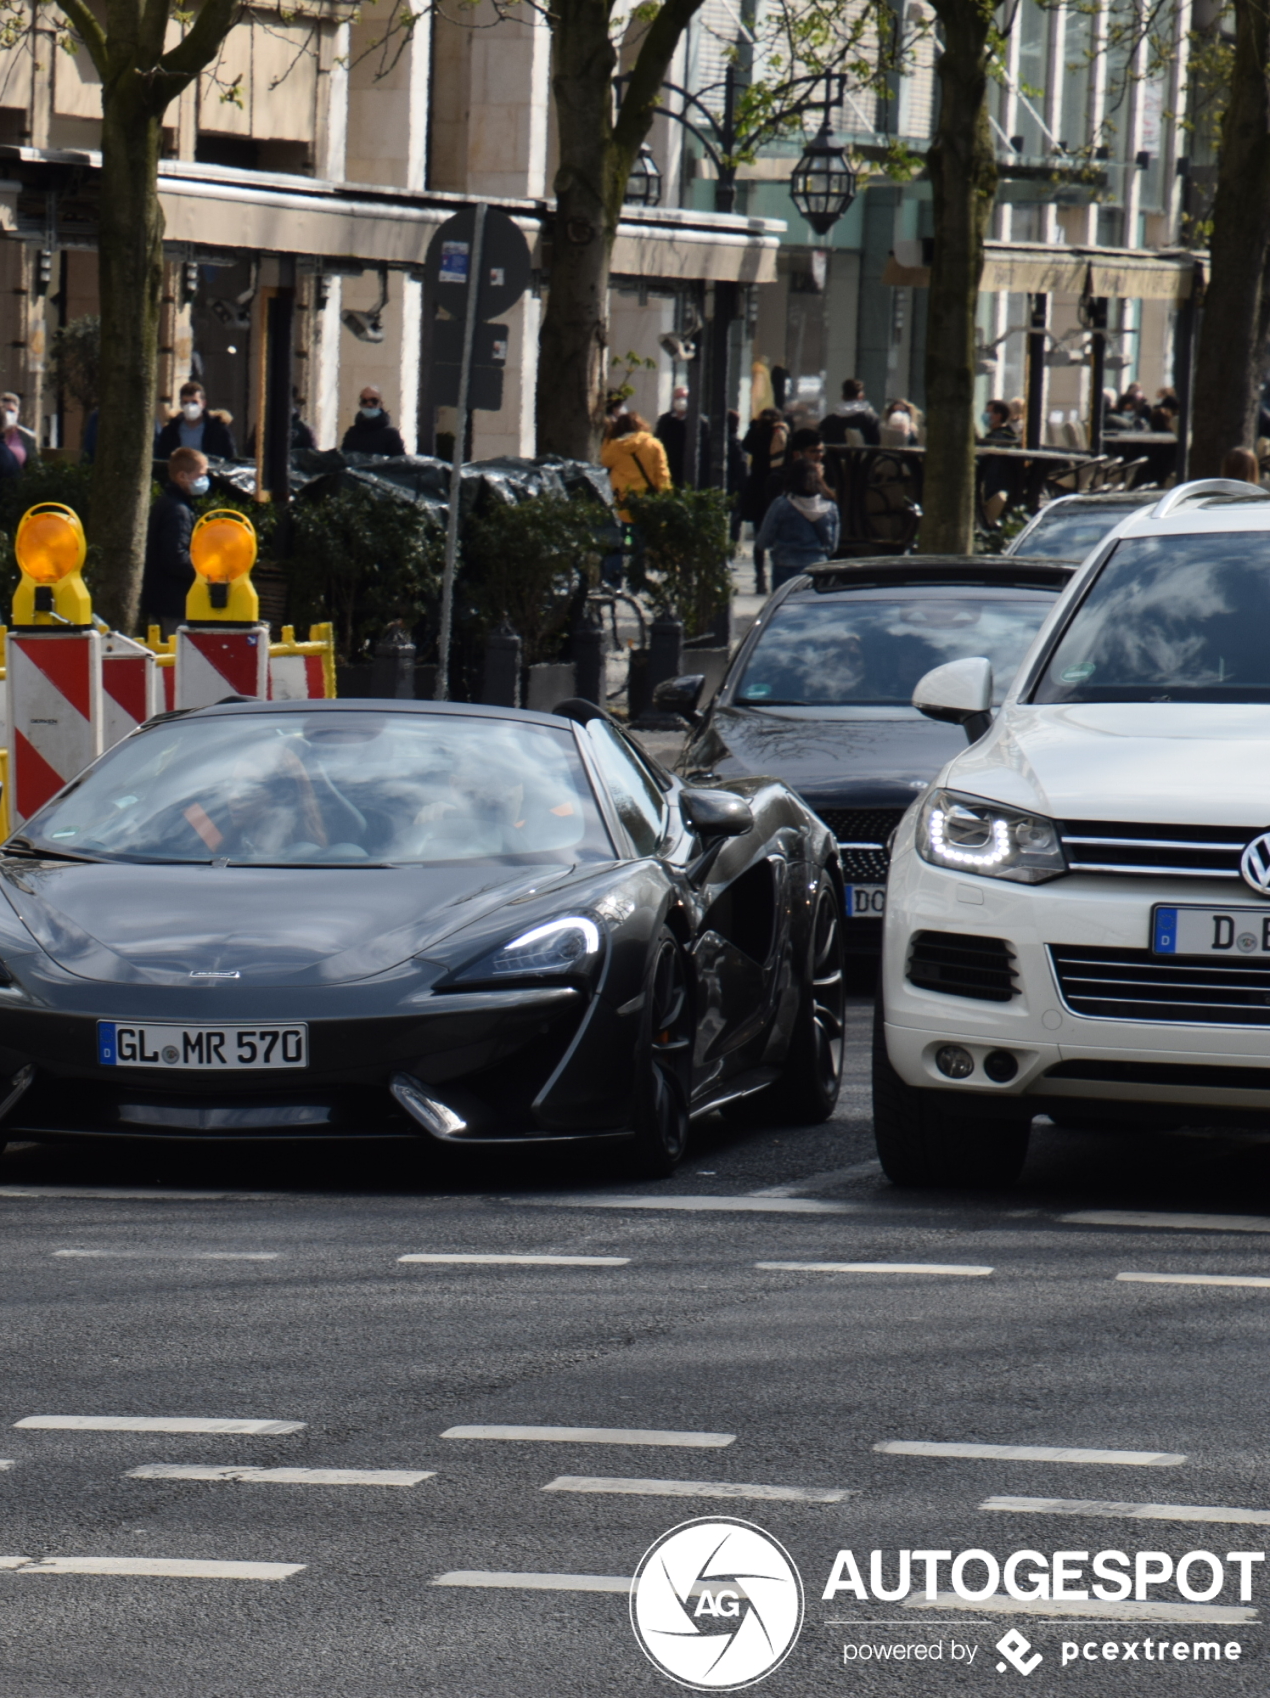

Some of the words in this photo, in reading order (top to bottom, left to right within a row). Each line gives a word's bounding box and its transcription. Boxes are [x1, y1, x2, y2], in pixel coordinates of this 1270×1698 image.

[1161, 935, 1170, 946] D
[1211, 914, 1235, 950] D
[117, 1028, 159, 1063] GL
[182, 1031, 227, 1065] MR
[237, 1030, 302, 1064] 570
